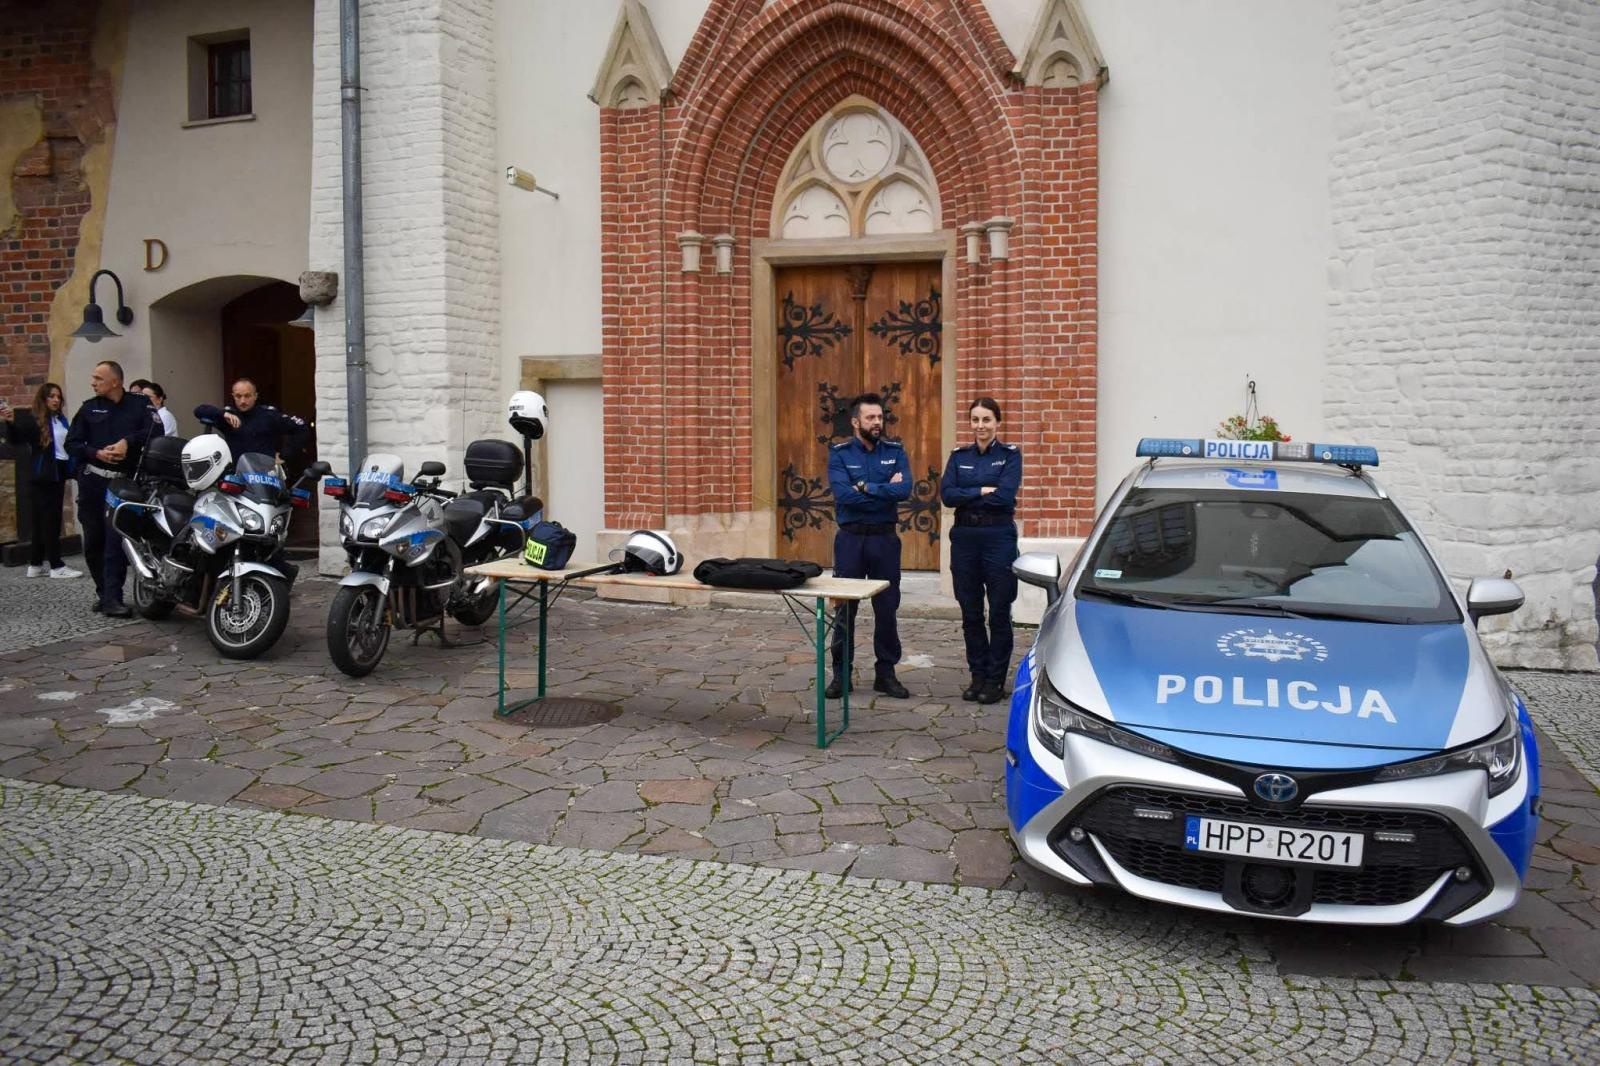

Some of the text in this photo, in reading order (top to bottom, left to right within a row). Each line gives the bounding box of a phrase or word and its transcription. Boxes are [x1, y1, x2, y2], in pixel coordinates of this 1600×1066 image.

[143, 239, 168, 271] D
[1206, 442, 1270, 459] POLICJA
[356, 472, 391, 486] POLICJA
[1156, 674, 1398, 724] POLICJA
[1186, 836, 1197, 845] PL
[1205, 822, 1351, 863] HPP R201
